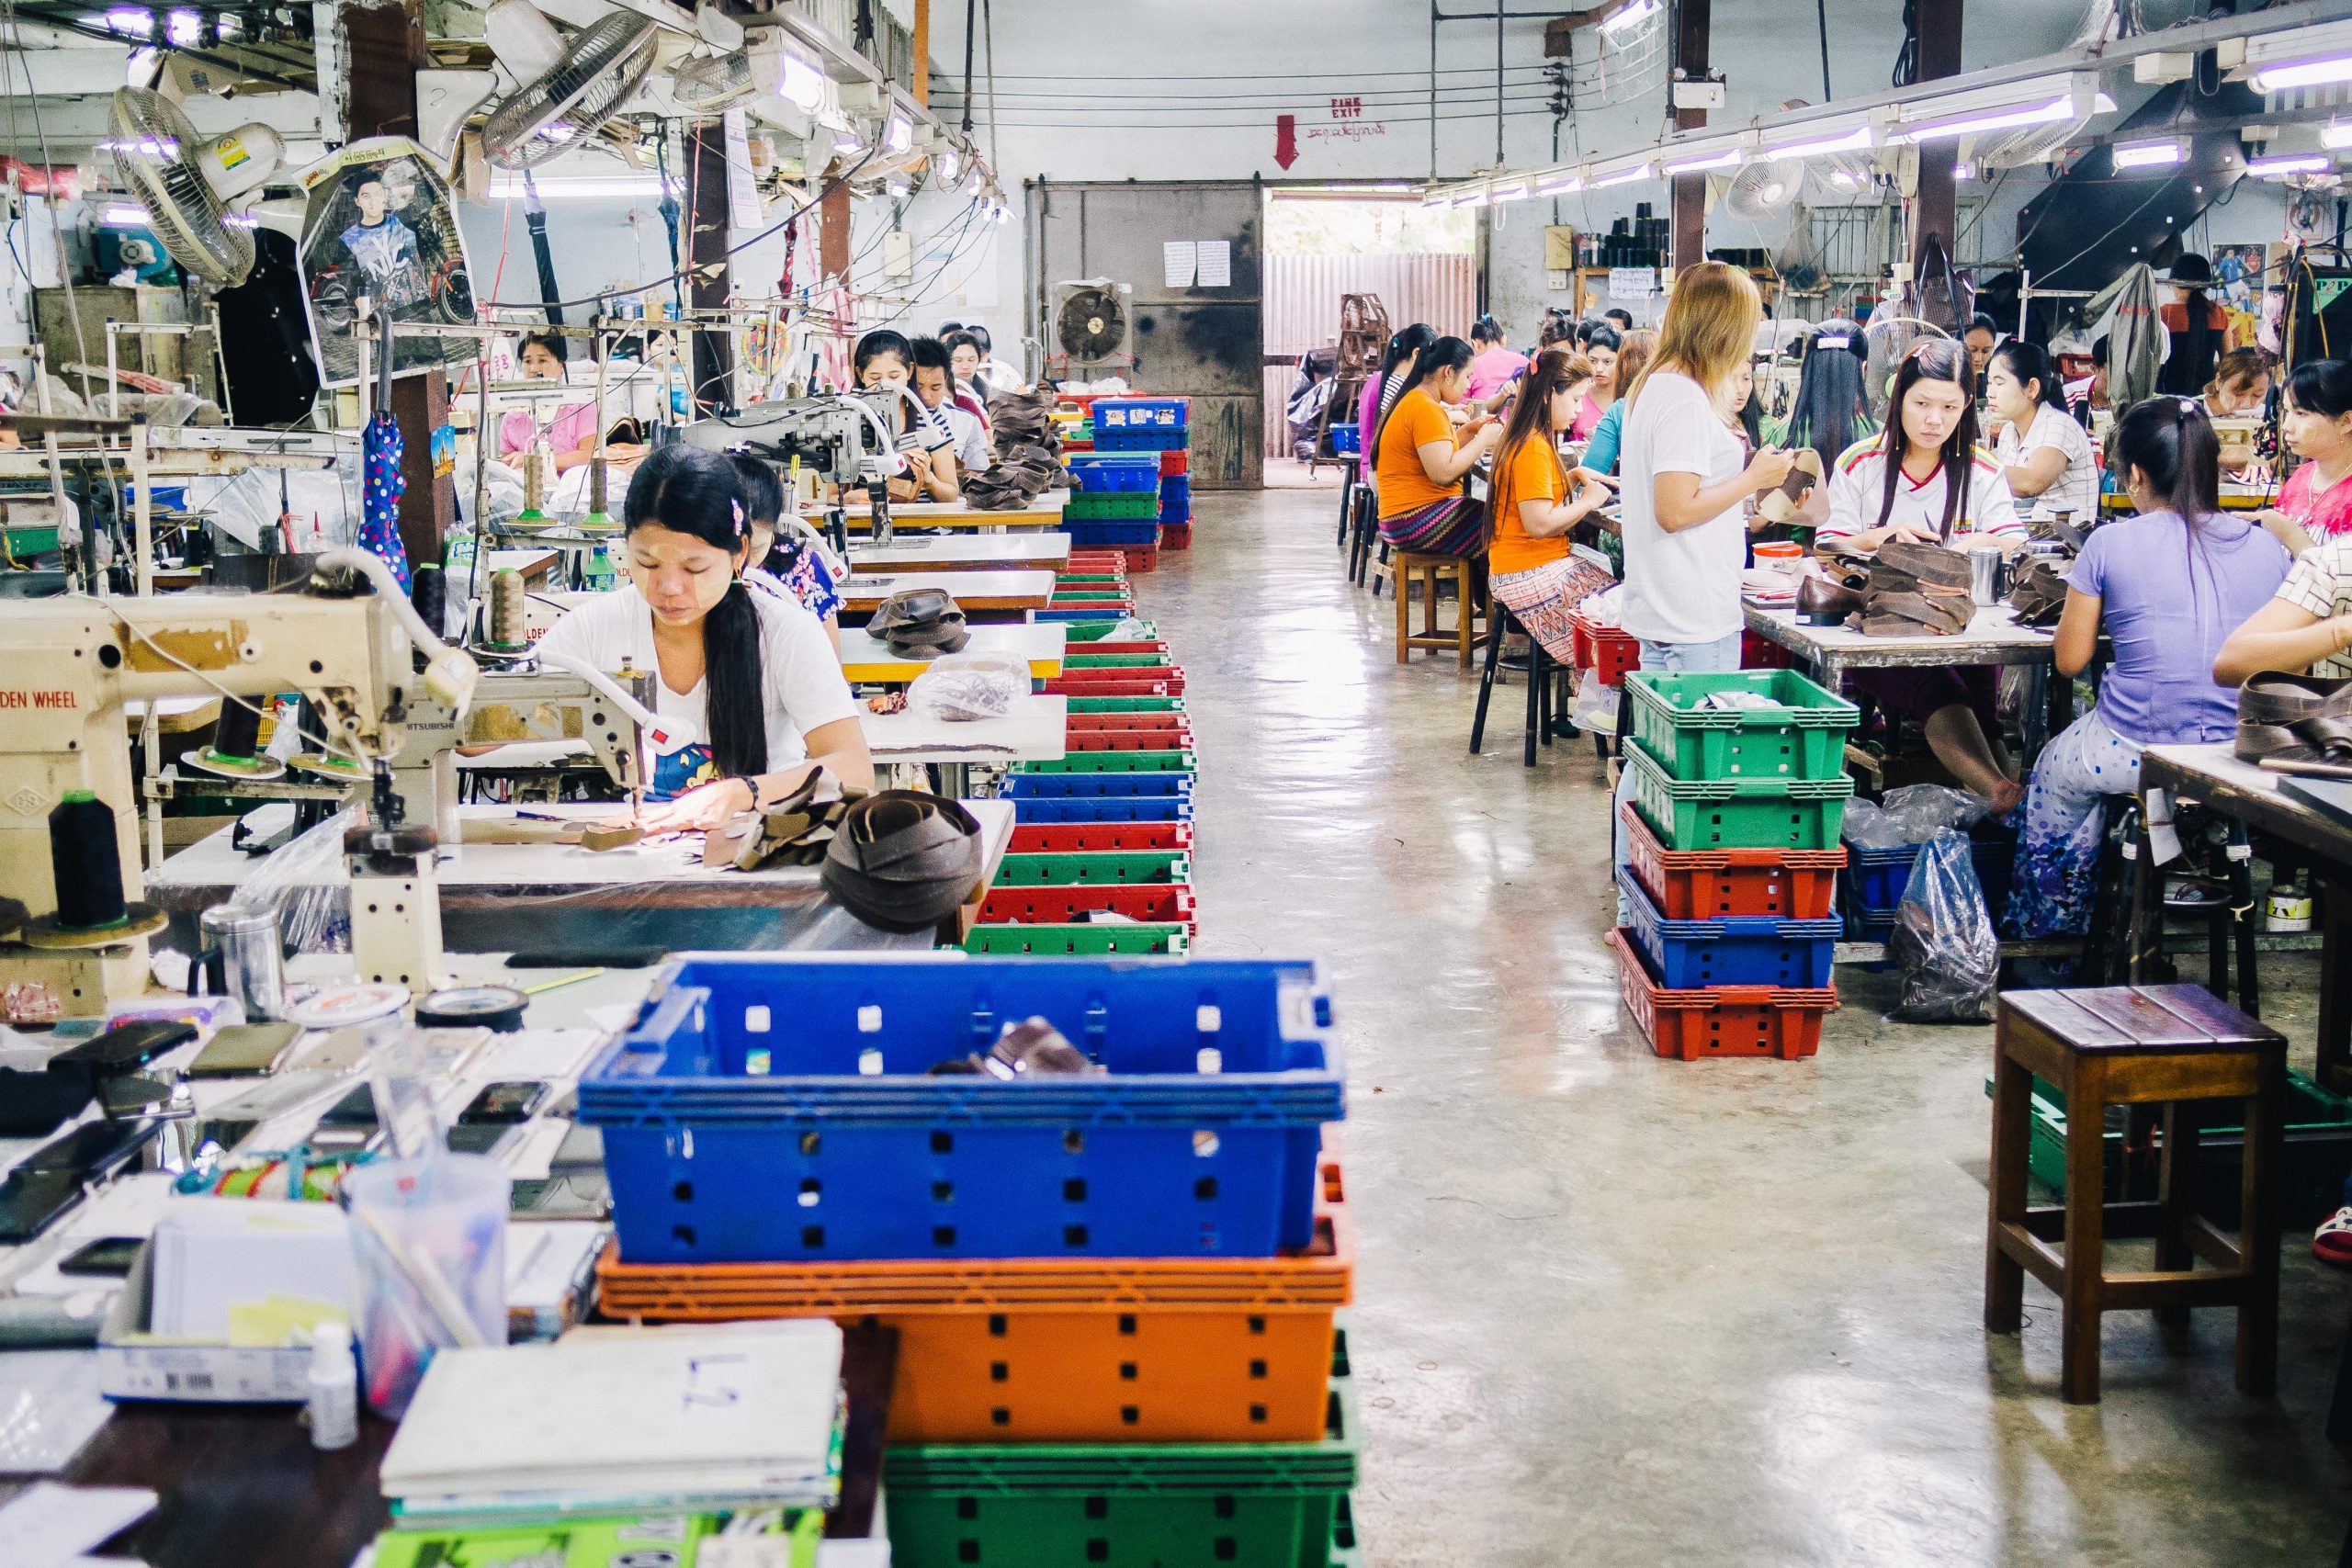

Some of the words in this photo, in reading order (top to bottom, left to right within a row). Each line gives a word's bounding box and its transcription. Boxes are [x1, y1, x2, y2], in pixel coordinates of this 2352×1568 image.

[1331, 97, 1362, 107] FIRE
[1332, 108, 1362, 118] EXIT
[0, 691, 28, 708] DEN
[32, 691, 78, 708] WHEEL
